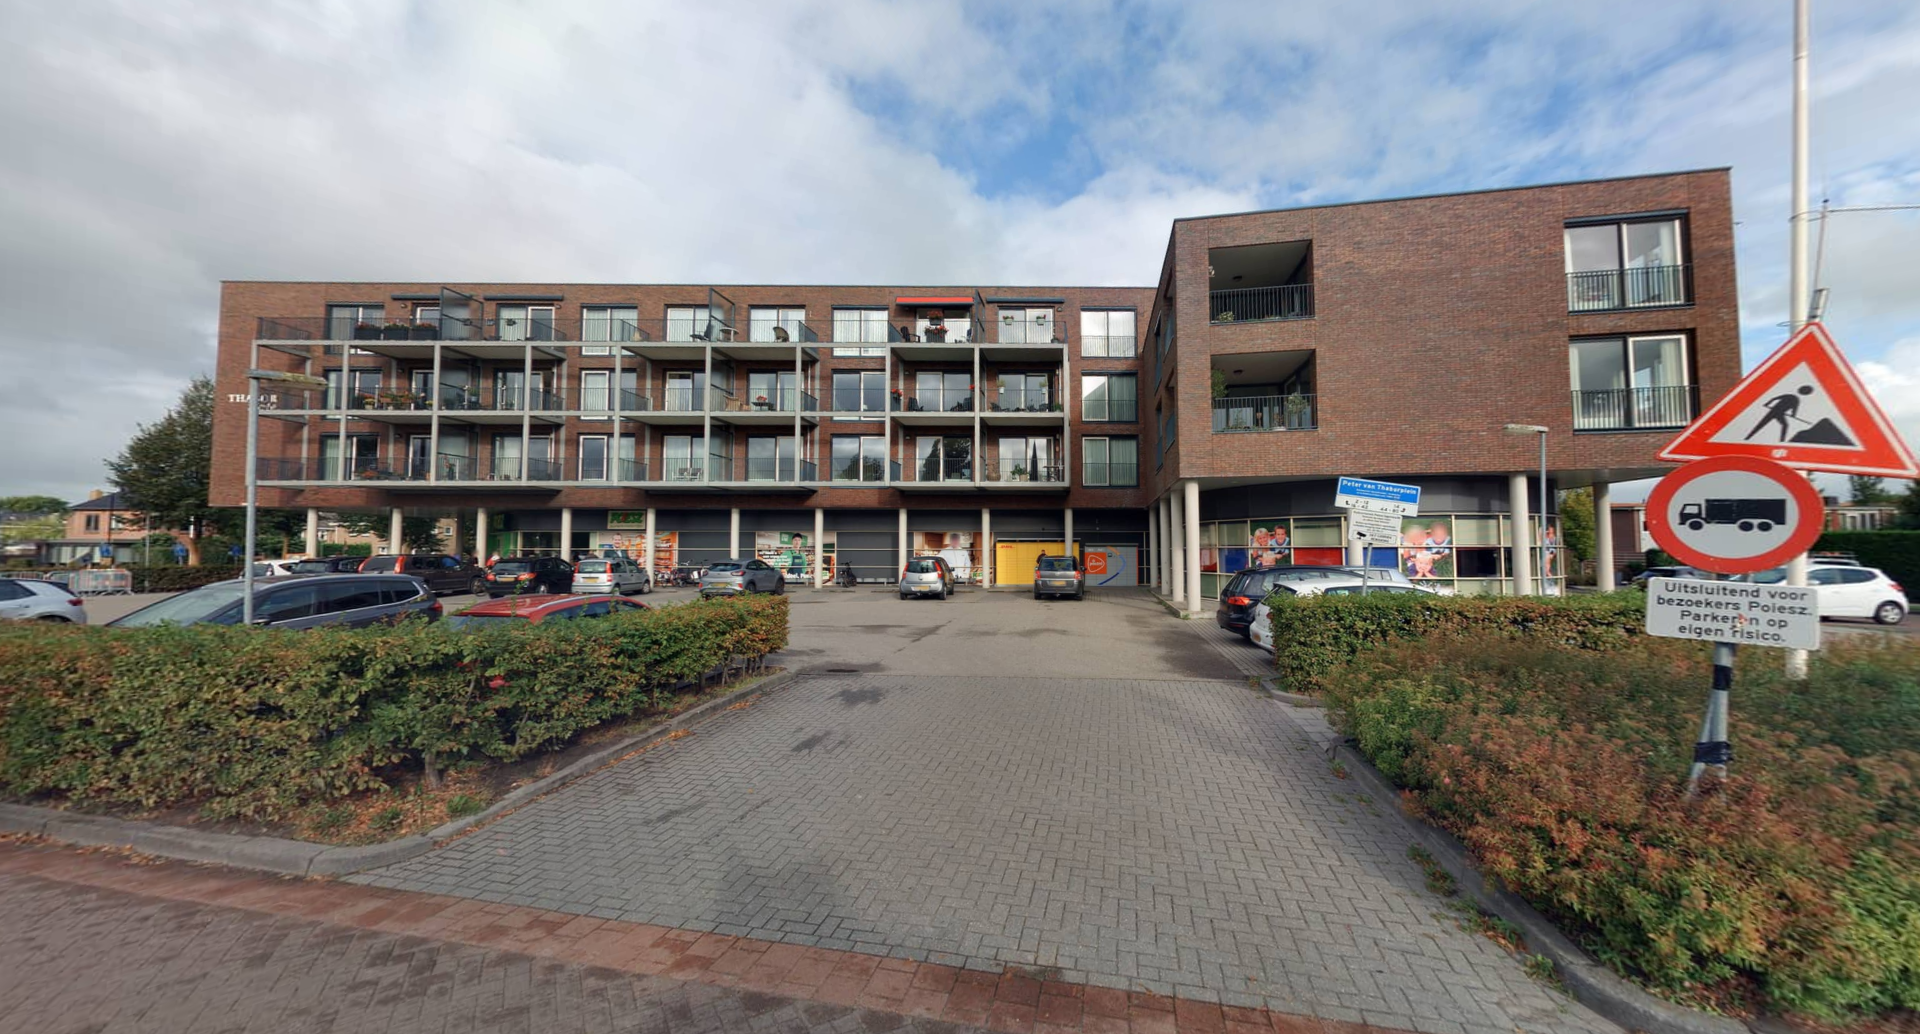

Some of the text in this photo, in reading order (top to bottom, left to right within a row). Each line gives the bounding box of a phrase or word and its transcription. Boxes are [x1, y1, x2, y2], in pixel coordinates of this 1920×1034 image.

[1342, 480, 1361, 488] Peter
[1665, 582, 1808, 601] Uitsluitend voor
[1656, 595, 1813, 616] bezoekers Poiesz.
[1680, 610, 1788, 629] Parkern op
[1678, 625, 1786, 642] eigen risico.
